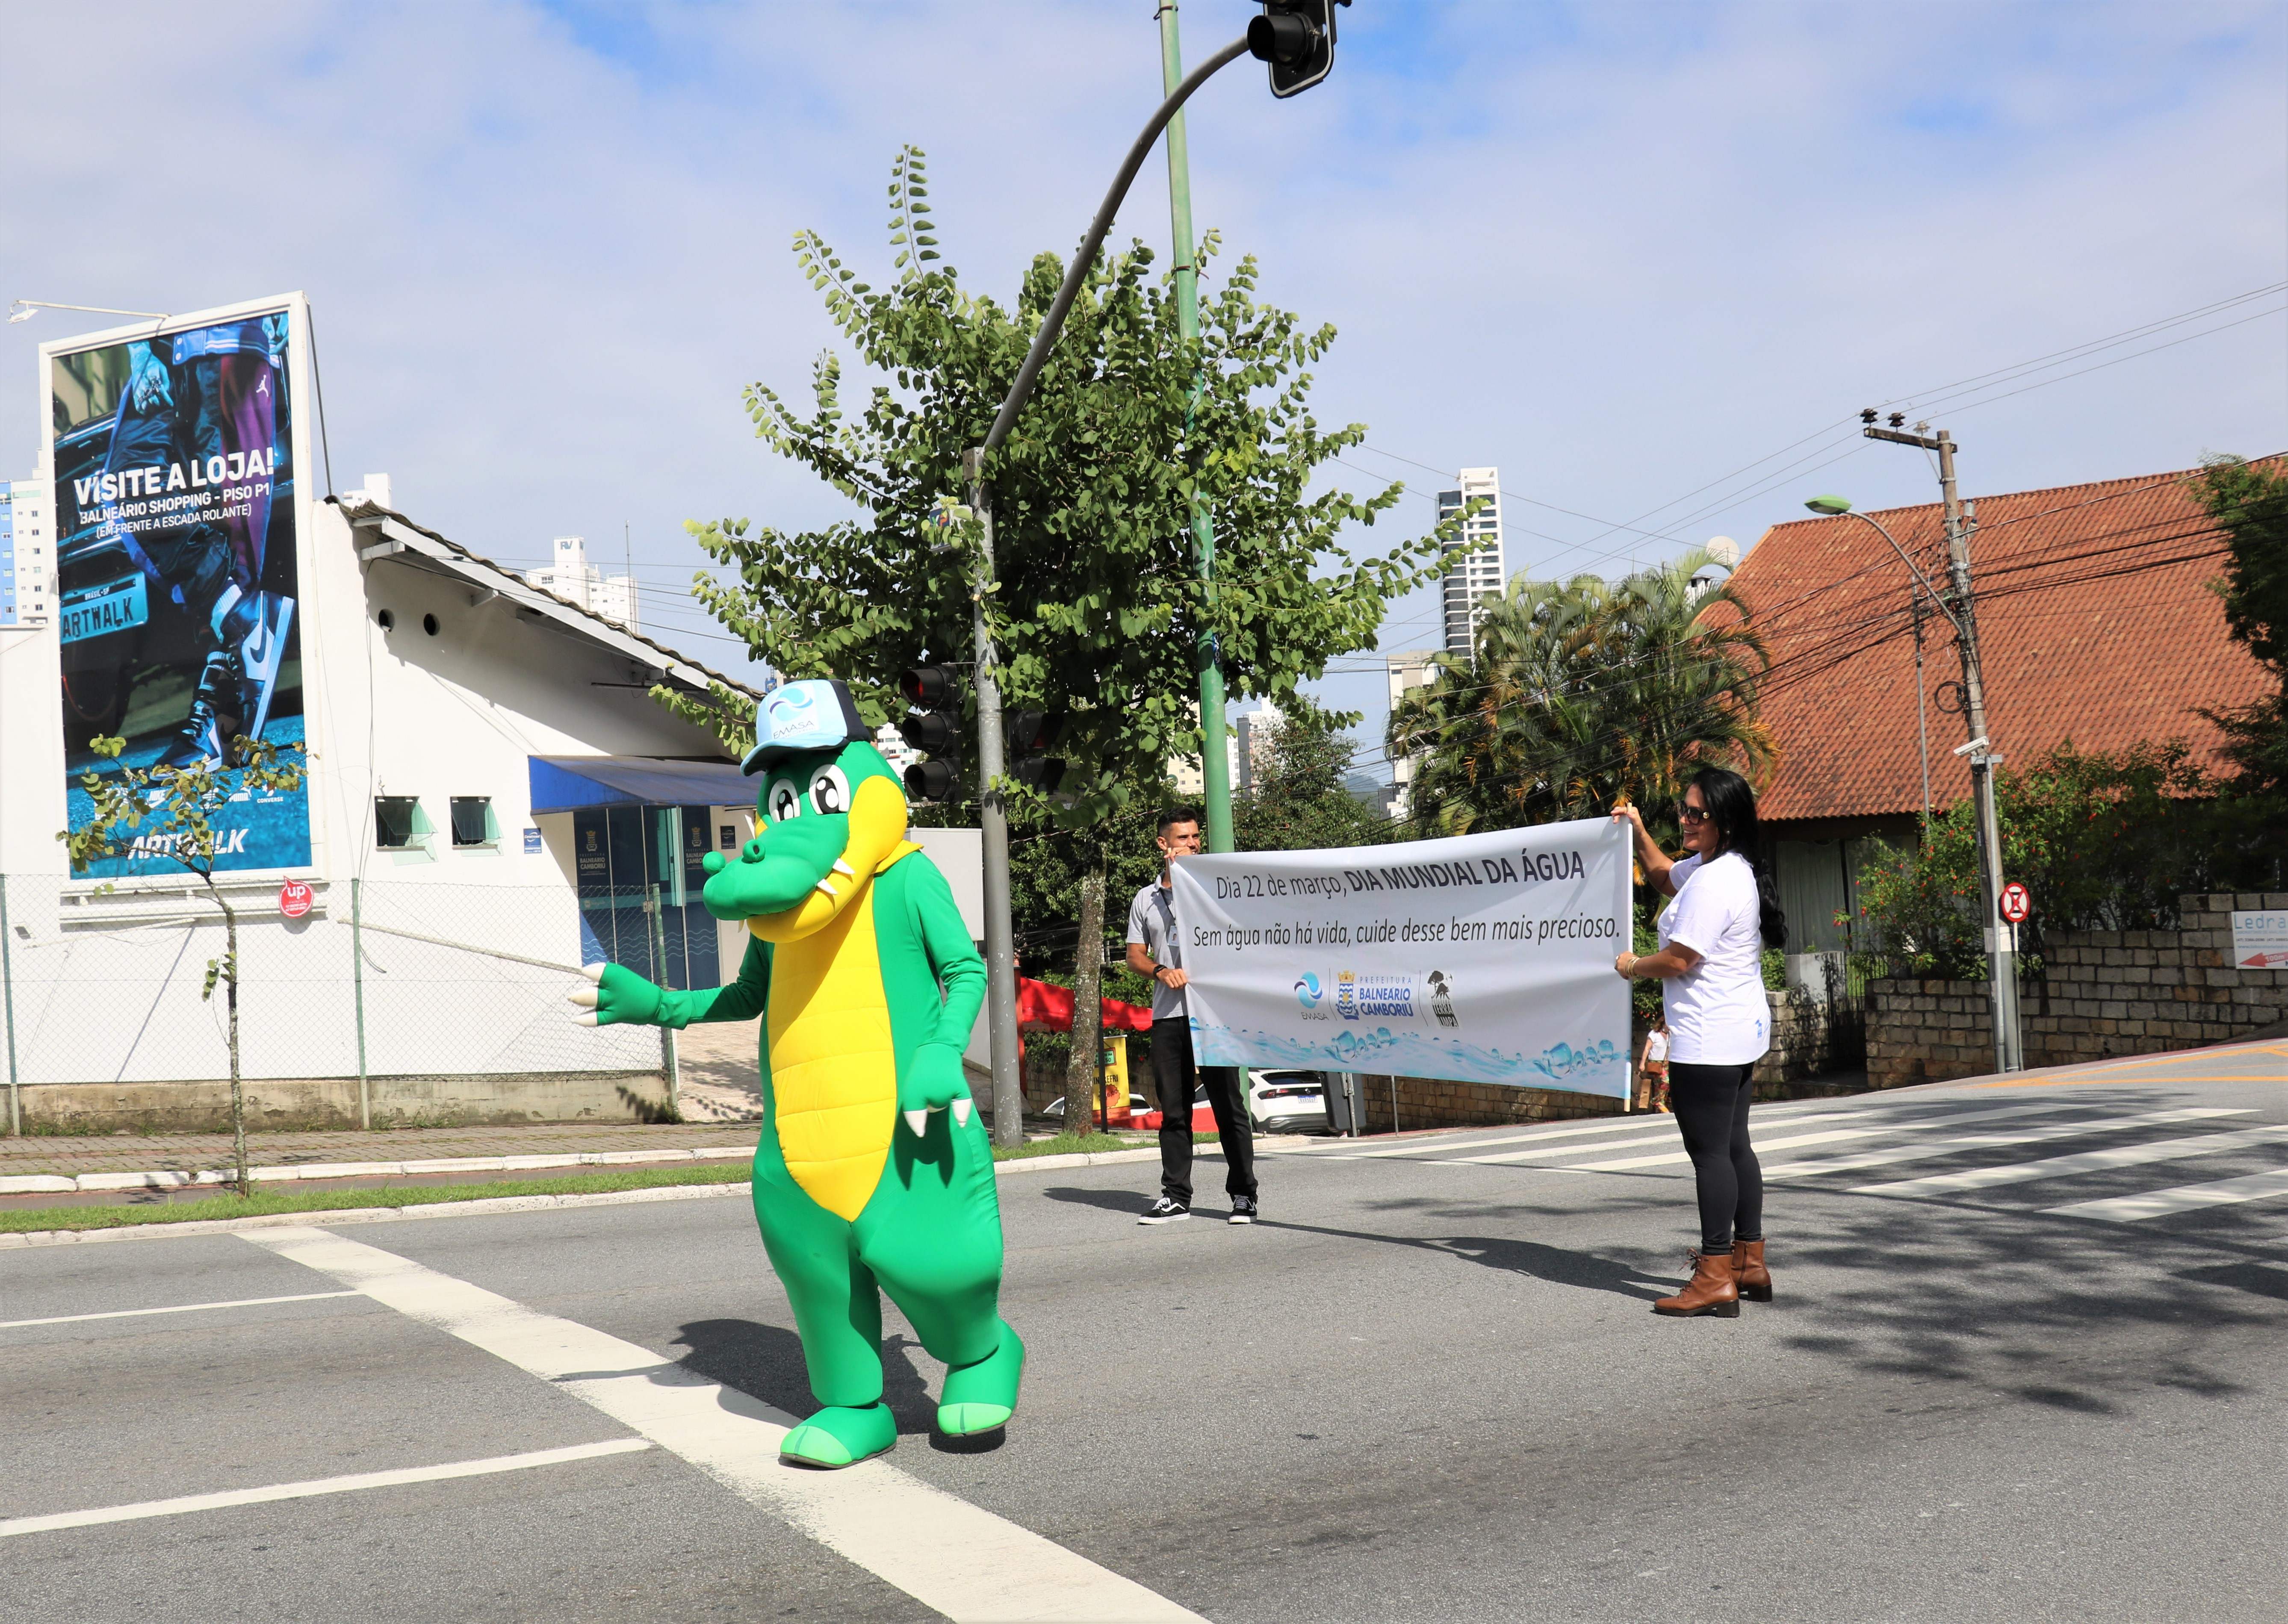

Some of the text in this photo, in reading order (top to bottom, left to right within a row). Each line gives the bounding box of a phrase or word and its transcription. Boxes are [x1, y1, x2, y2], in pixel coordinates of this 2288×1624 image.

[74, 447, 274, 505] VISITE A LOJA!
[80, 502, 147, 525] BALNEÁRIO
[149, 492, 212, 514] SHOPPING
[223, 486, 252, 502] PISO
[255, 482, 270, 497] P1
[115, 519, 152, 534] FRENTE
[153, 518, 161, 529] A
[162, 512, 201, 528] ESCADA
[202, 503, 252, 521] ROLANTE)
[62, 596, 133, 638] ARTWALK
[773, 720, 815, 740] EMASA
[127, 828, 249, 860] ARTLK
[1216, 848, 1585, 899] Dia 22 de março, DIA MUNDIAL DA ÁGUA
[287, 885, 306, 899] up
[1194, 912, 1620, 950] Sem água não há vida, cuide desse bem mais precioso.
[2234, 914, 2286, 929] Ledra
[1359, 987, 1411, 1000] BALNEÁRIO
[1301, 1012, 1329, 1020] EMASA
[1360, 1002, 1414, 1017] CAMBORIÚ
